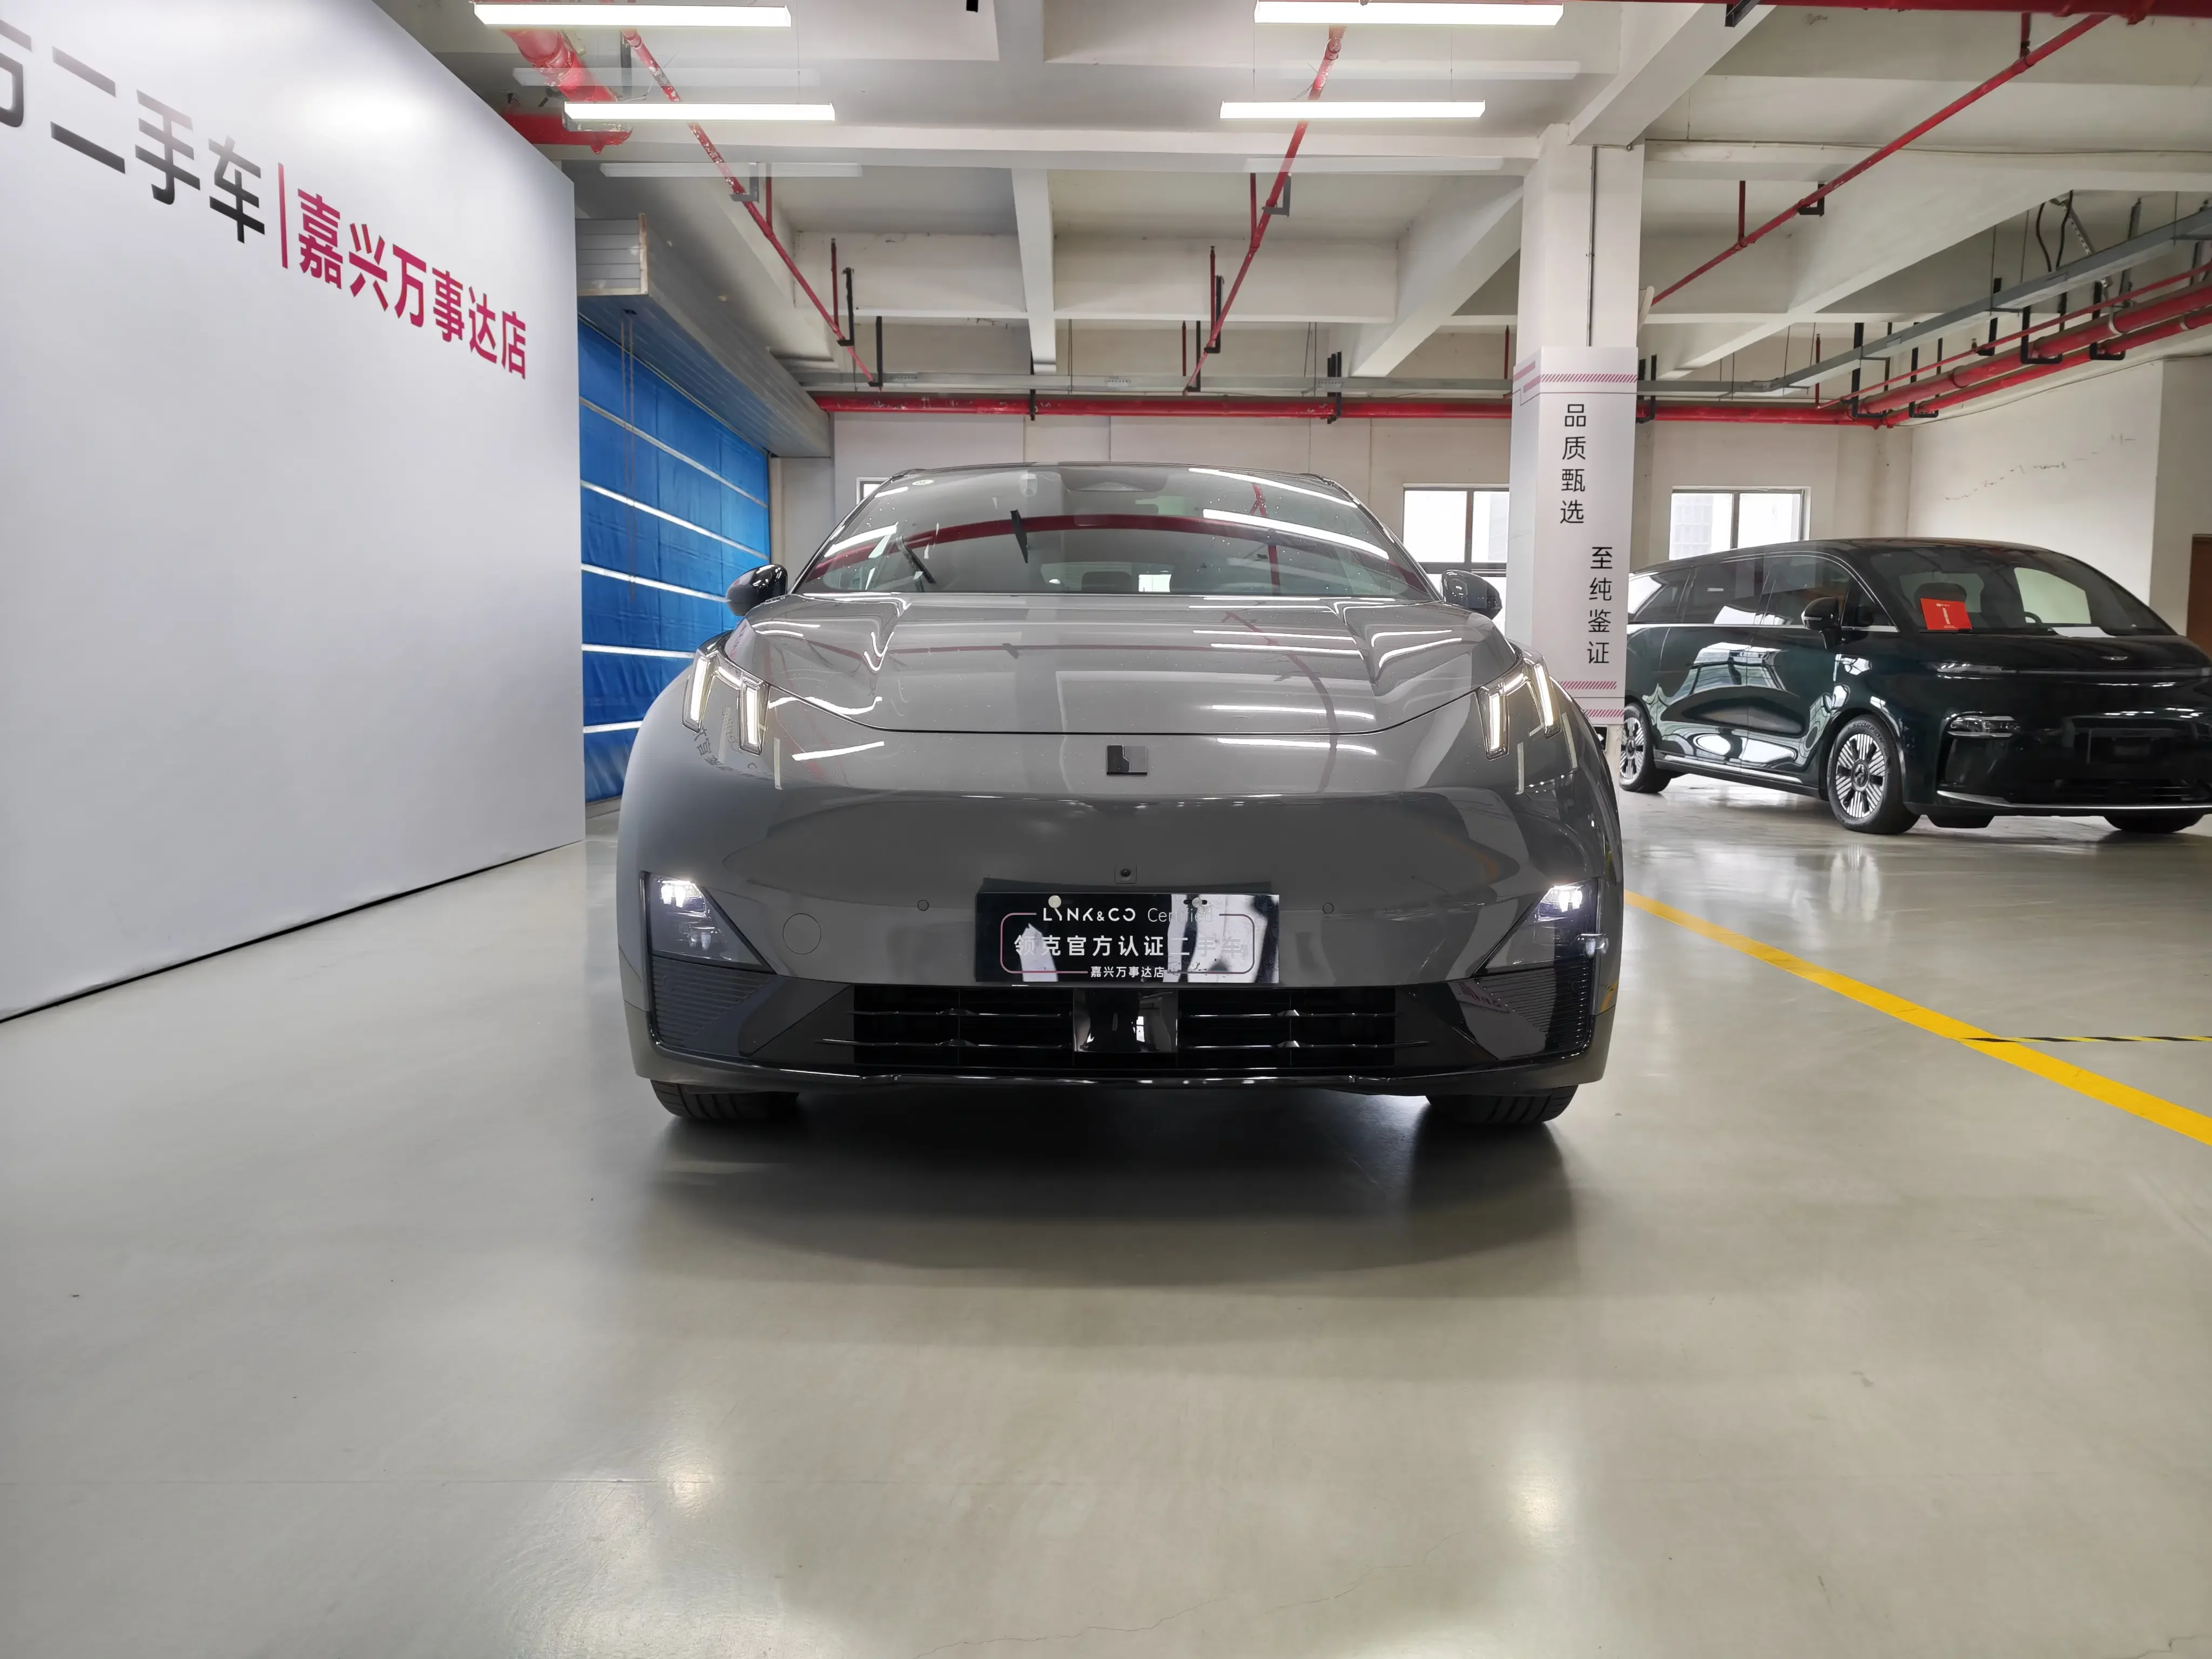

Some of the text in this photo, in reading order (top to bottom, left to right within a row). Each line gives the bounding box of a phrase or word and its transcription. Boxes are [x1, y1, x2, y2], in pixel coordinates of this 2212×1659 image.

[297, 188, 527, 379] 嘉兴万事达店
[1560, 403, 1587, 524] 品质甄选
[1587, 546, 1613, 665] 至纯鉴证
[1014, 935, 1242, 957] 领克官方认证二手车
[1090, 966, 1165, 978] 嘉兴万事达店
